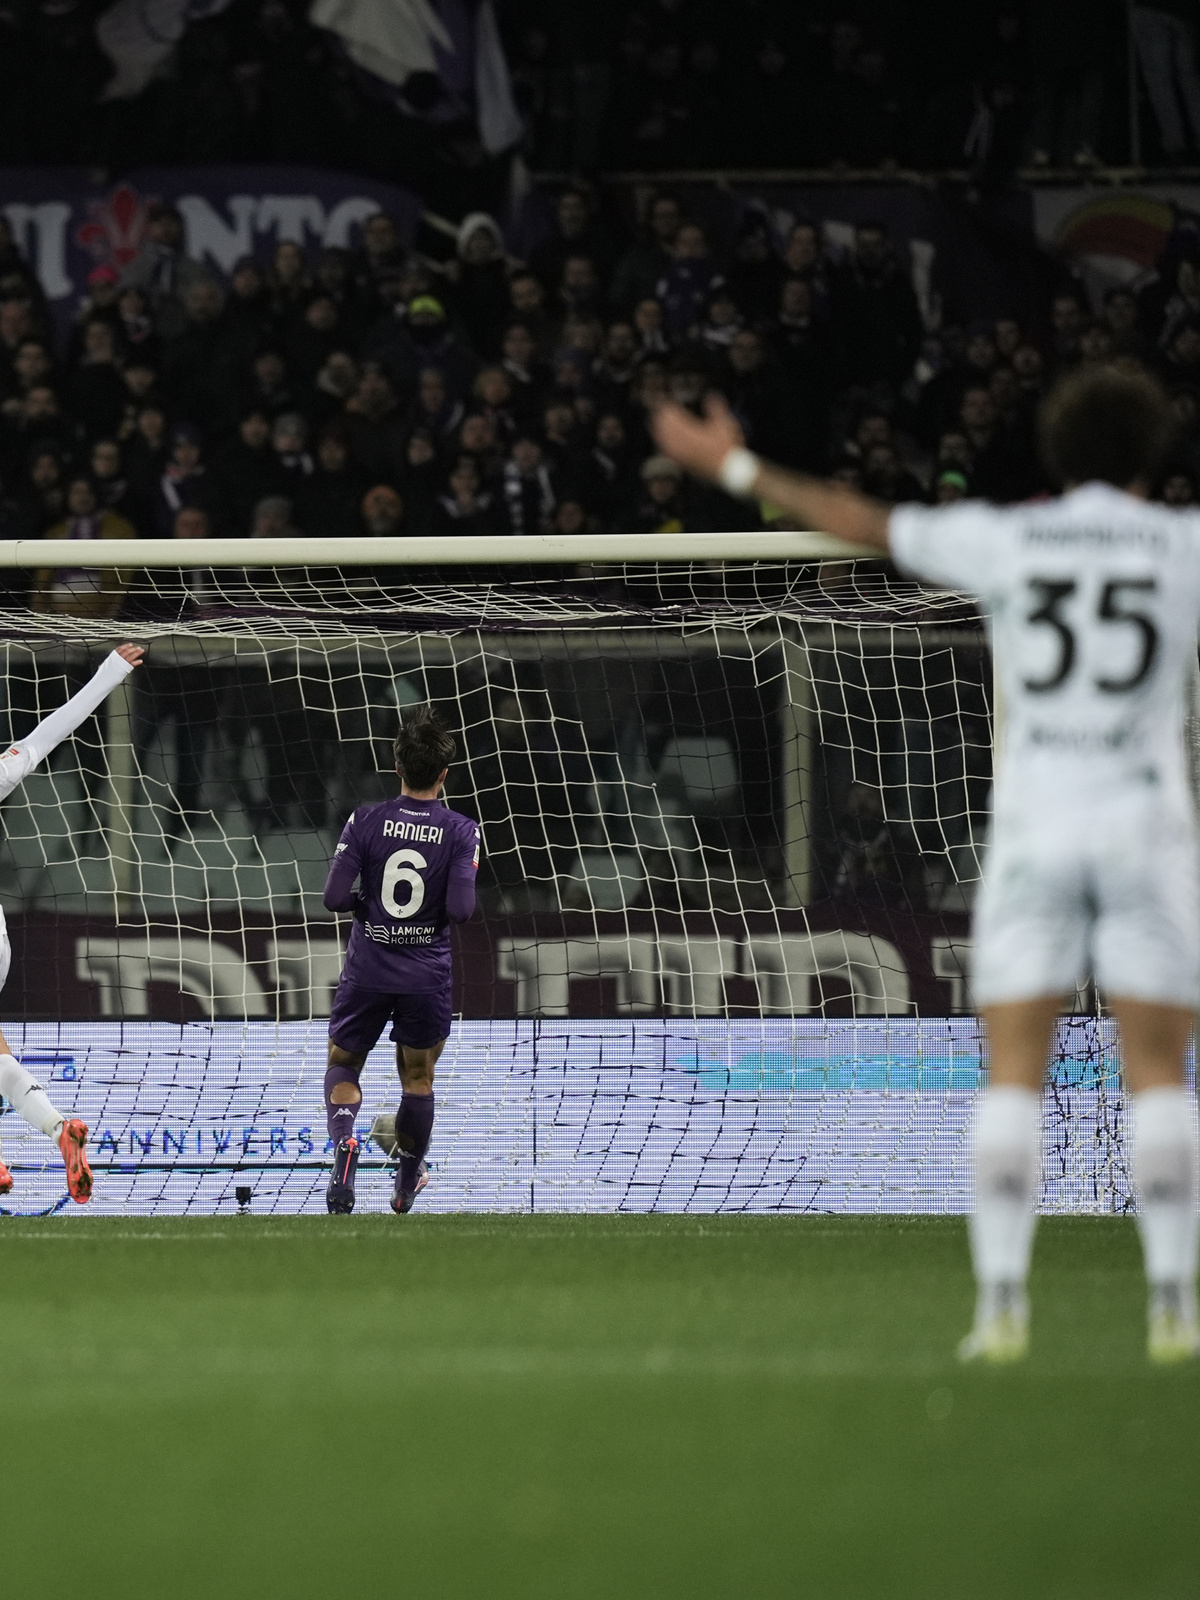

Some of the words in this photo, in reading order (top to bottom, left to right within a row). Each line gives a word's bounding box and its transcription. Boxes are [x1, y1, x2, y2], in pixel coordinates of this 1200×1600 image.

[1024, 575, 1160, 692] 35
[399, 808, 430, 817] FIORENTINA
[383, 820, 443, 845] RANIERI
[381, 849, 428, 919] 6
[391, 935, 432, 944] HOLDING
[392, 926, 434, 936] LAMIONI
